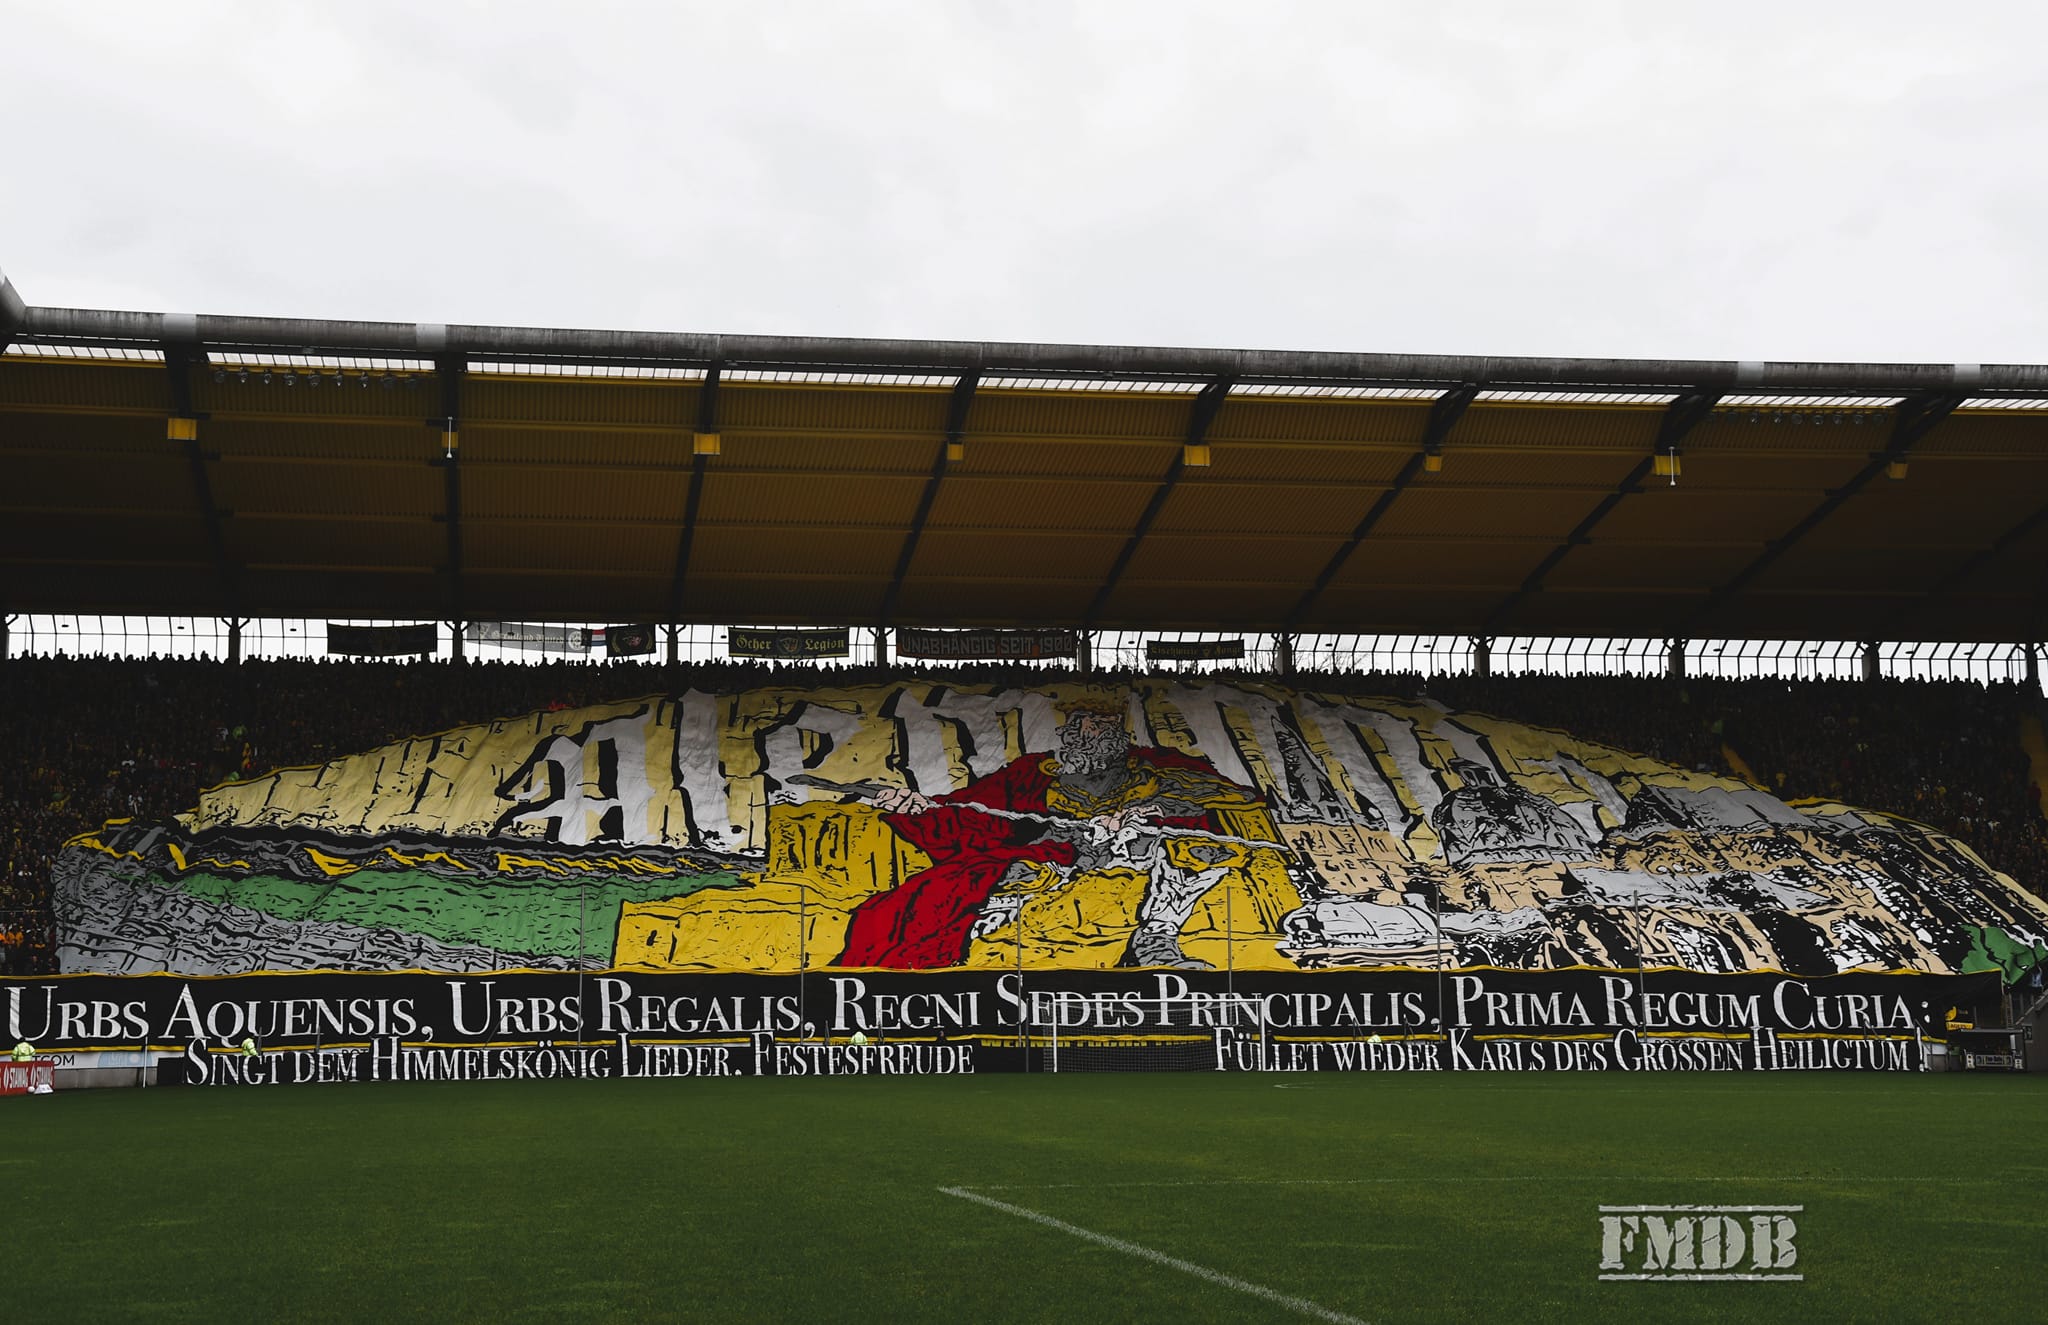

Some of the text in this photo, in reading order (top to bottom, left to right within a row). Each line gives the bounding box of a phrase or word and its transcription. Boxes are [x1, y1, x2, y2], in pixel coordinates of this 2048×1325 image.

[804, 638, 845, 651] Legion
[901, 633, 1073, 654] UNABHÄNGIG SEIT 1900
[8, 986, 148, 1041] URBS
[157, 984, 434, 1048] AQUENSIS,
[445, 981, 584, 1035] URBS
[594, 977, 816, 1038] REGALIS,
[829, 977, 981, 1030] REGNI
[997, 973, 1145, 1027] SEDES
[1153, 973, 1442, 1032] PRINCIPALIS,
[1454, 975, 1596, 1027] PRIMA
[1600, 975, 1764, 1029] REGUM
[186, 1038, 284, 1086] SINGT
[293, 1050, 361, 1083] DEM
[370, 1036, 611, 1081] HIMMELSKÖNIG
[750, 1030, 976, 1075] FESTESFREUDE
[1214, 1026, 1323, 1072] FÜLLET
[1329, 1040, 1443, 1072] WIEDER
[1551, 1040, 1608, 1071] DES
[1613, 1028, 1744, 1071] GROSSEN
